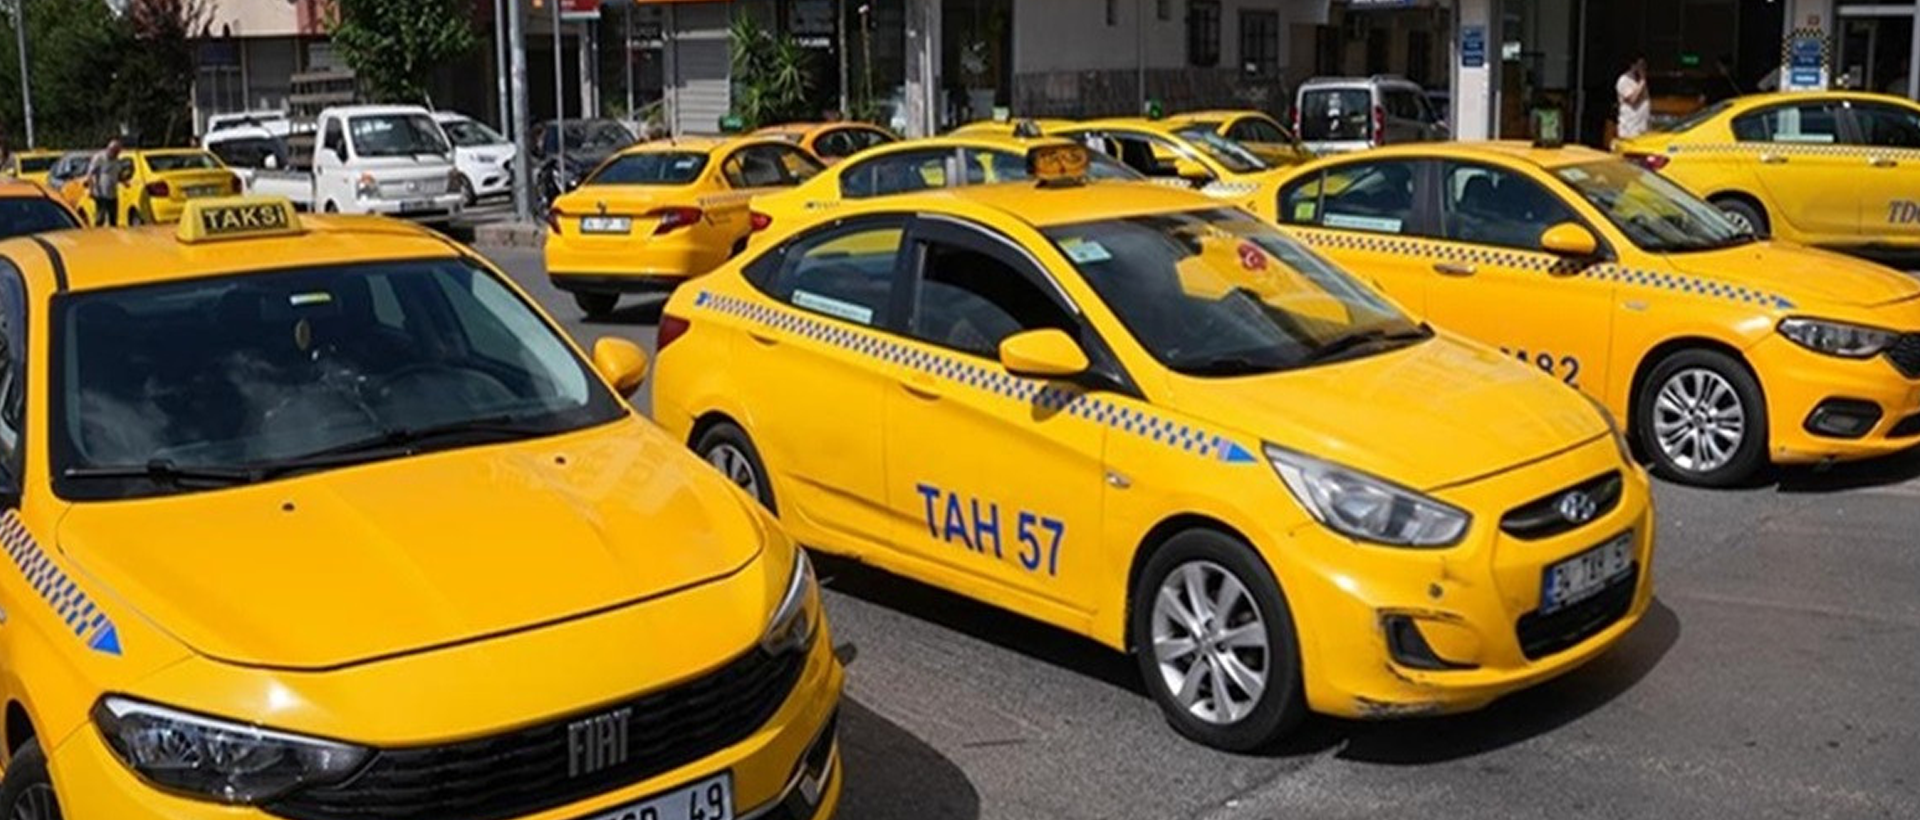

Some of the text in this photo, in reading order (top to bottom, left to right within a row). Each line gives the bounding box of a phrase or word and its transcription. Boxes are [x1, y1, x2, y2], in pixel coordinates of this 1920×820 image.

[1888, 200, 1920, 224] TD
[916, 483, 1064, 576] TAH 57
[568, 707, 632, 778] FIAT
[689, 782, 724, 820] 49
